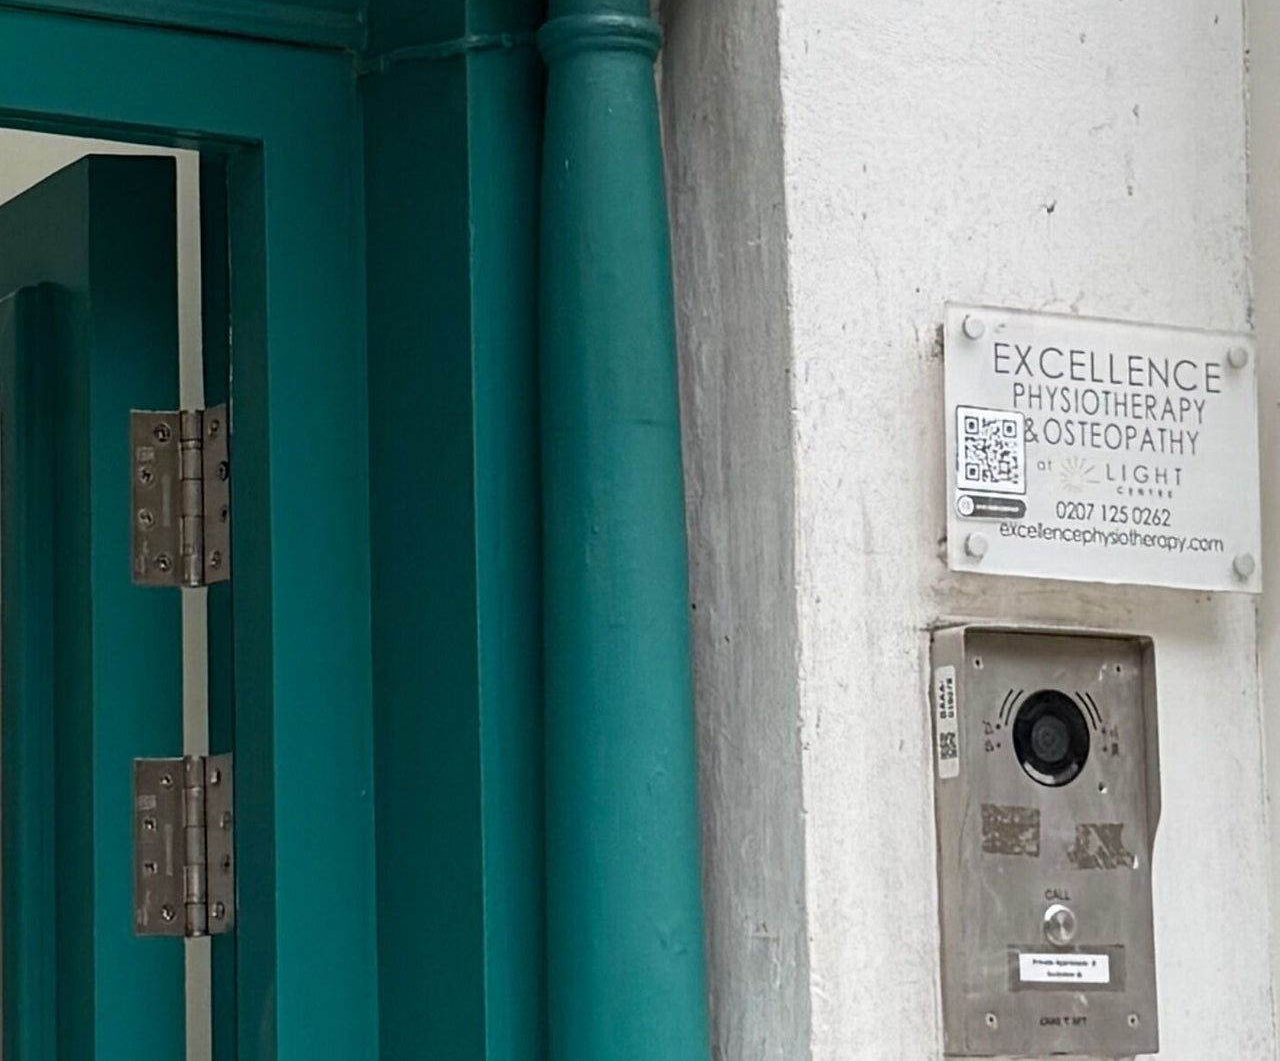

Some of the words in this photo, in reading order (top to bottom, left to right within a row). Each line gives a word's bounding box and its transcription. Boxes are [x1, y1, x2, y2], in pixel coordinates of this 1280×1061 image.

[993, 342, 1222, 394] EXCELLENCE
[1012, 382, 1206, 425] PHYSIOTHERAPY
[1023, 418, 1040, 444] &
[1043, 418, 1200, 456] OSTEOPATHY
[1037, 459, 1052, 472] at
[1105, 463, 1183, 486] LIGHT
[1056, 500, 1095, 521] 0207
[1101, 504, 1129, 525] 125
[1131, 507, 1172, 528] 0262
[1044, 888, 1071, 901] CALL
